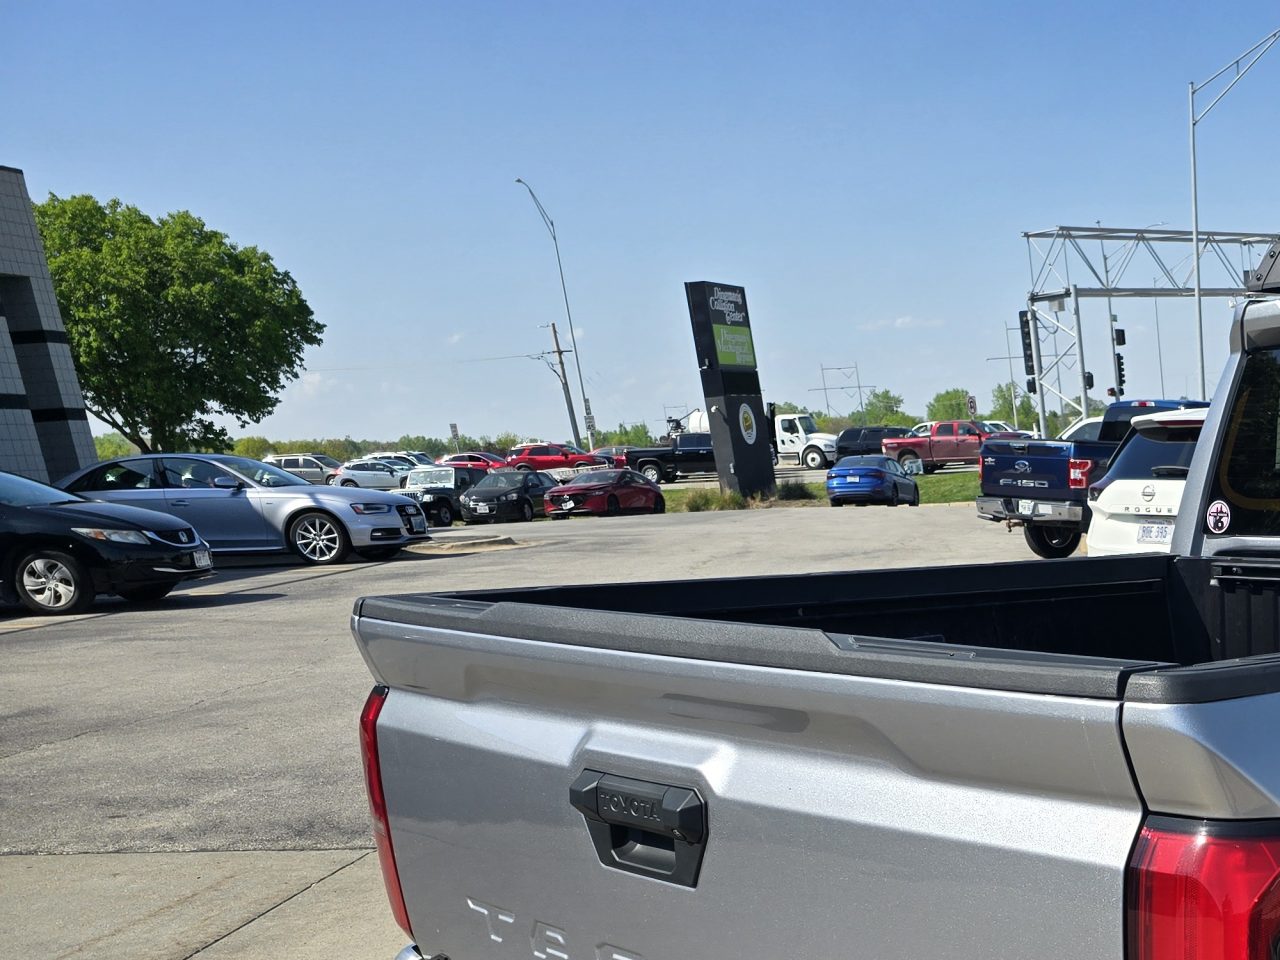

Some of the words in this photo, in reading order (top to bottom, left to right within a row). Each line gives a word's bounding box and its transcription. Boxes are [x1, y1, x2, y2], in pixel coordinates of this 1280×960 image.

[1000, 479, 1049, 488] F-150
[1124, 506, 1173, 514] ROGUE
[600, 791, 661, 822] TOYOTA
